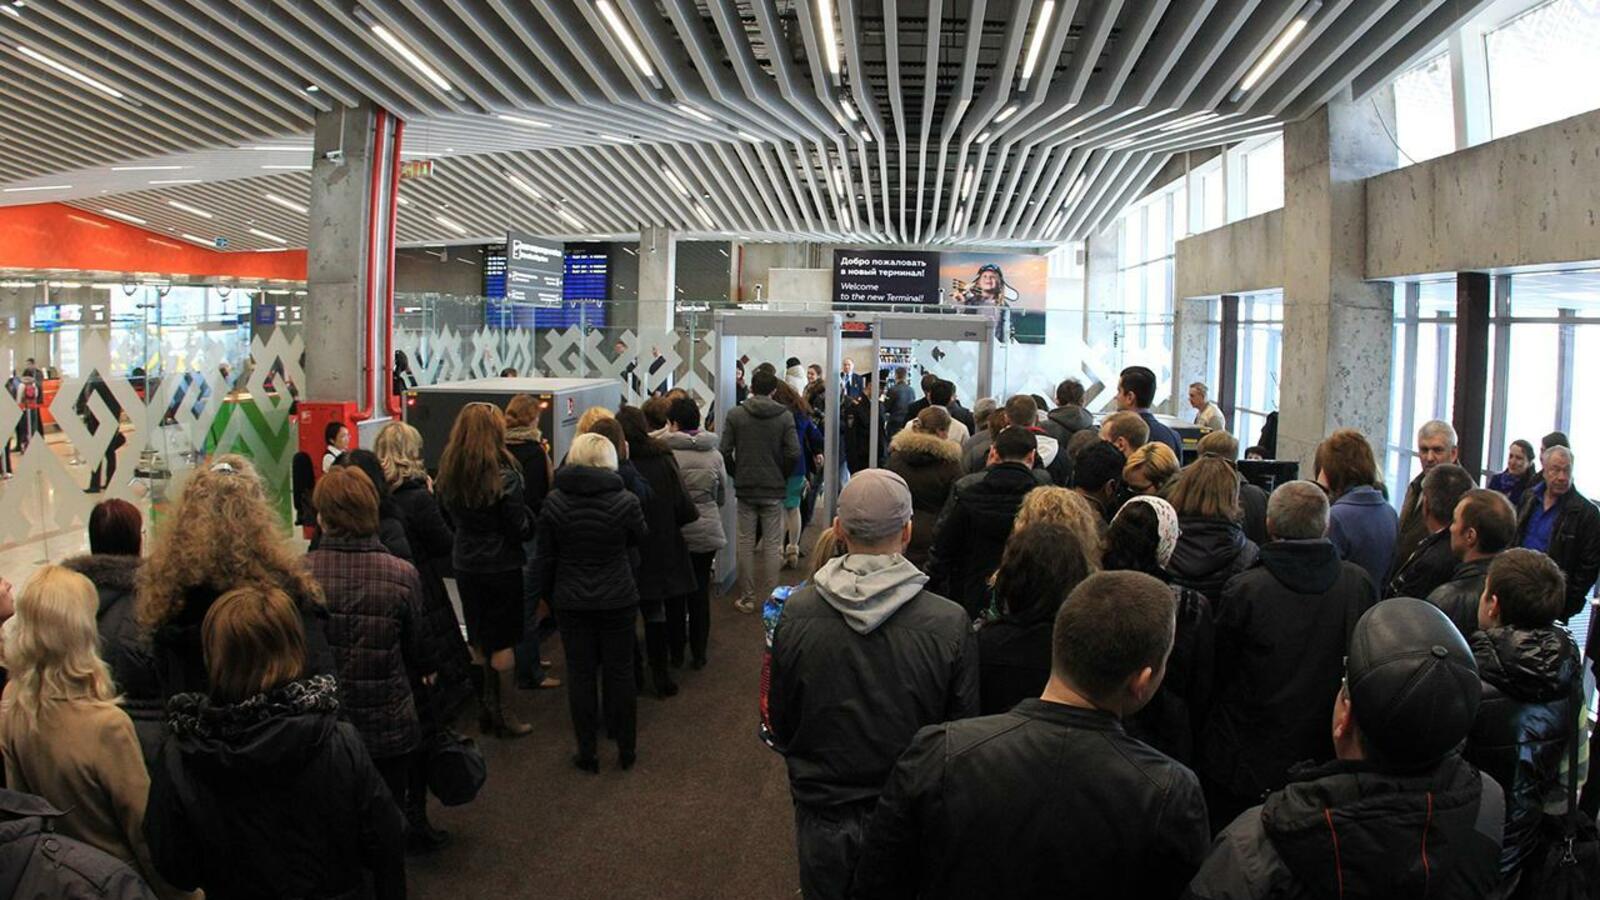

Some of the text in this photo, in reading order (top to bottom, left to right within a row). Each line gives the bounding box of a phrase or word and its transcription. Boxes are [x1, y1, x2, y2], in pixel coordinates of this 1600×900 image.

[840, 257, 927, 266] Добро пожаловать
[879, 269, 925, 277] терминал!
[840, 282, 879, 291] Welcome
[887, 293, 924, 302] Terminal!
